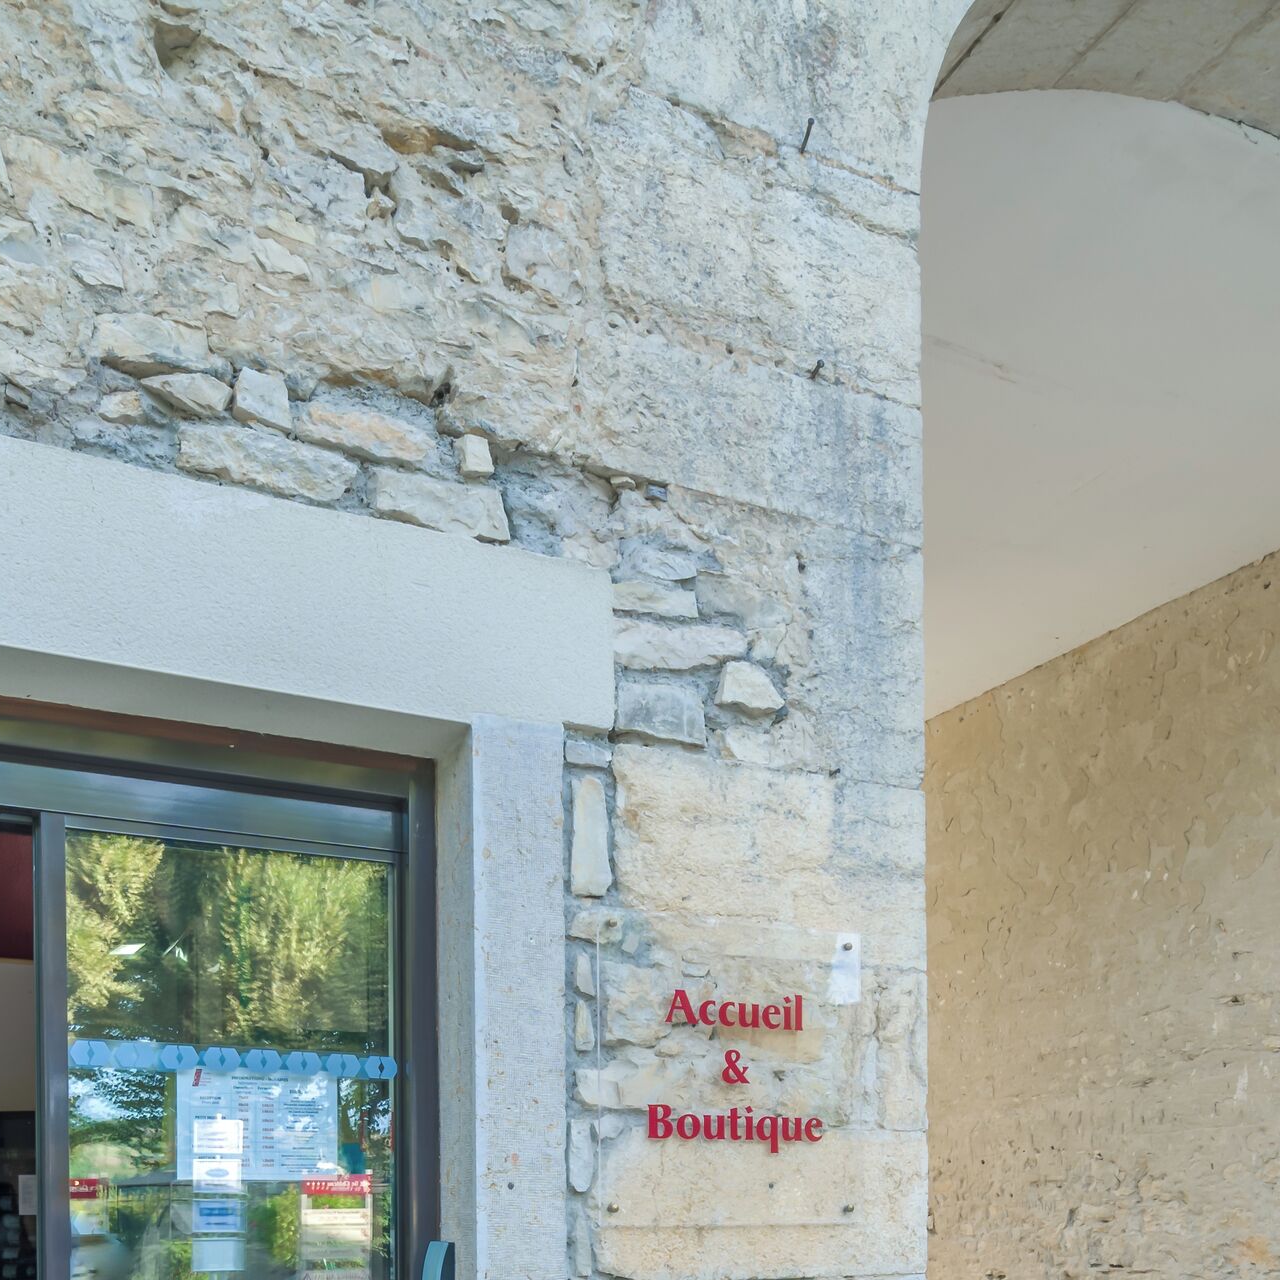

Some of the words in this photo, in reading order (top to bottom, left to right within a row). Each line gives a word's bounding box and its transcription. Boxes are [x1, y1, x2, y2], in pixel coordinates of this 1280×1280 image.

[664, 988, 804, 1032] Accueil
[721, 1048, 751, 1085] &
[647, 1104, 824, 1153] Boutique
